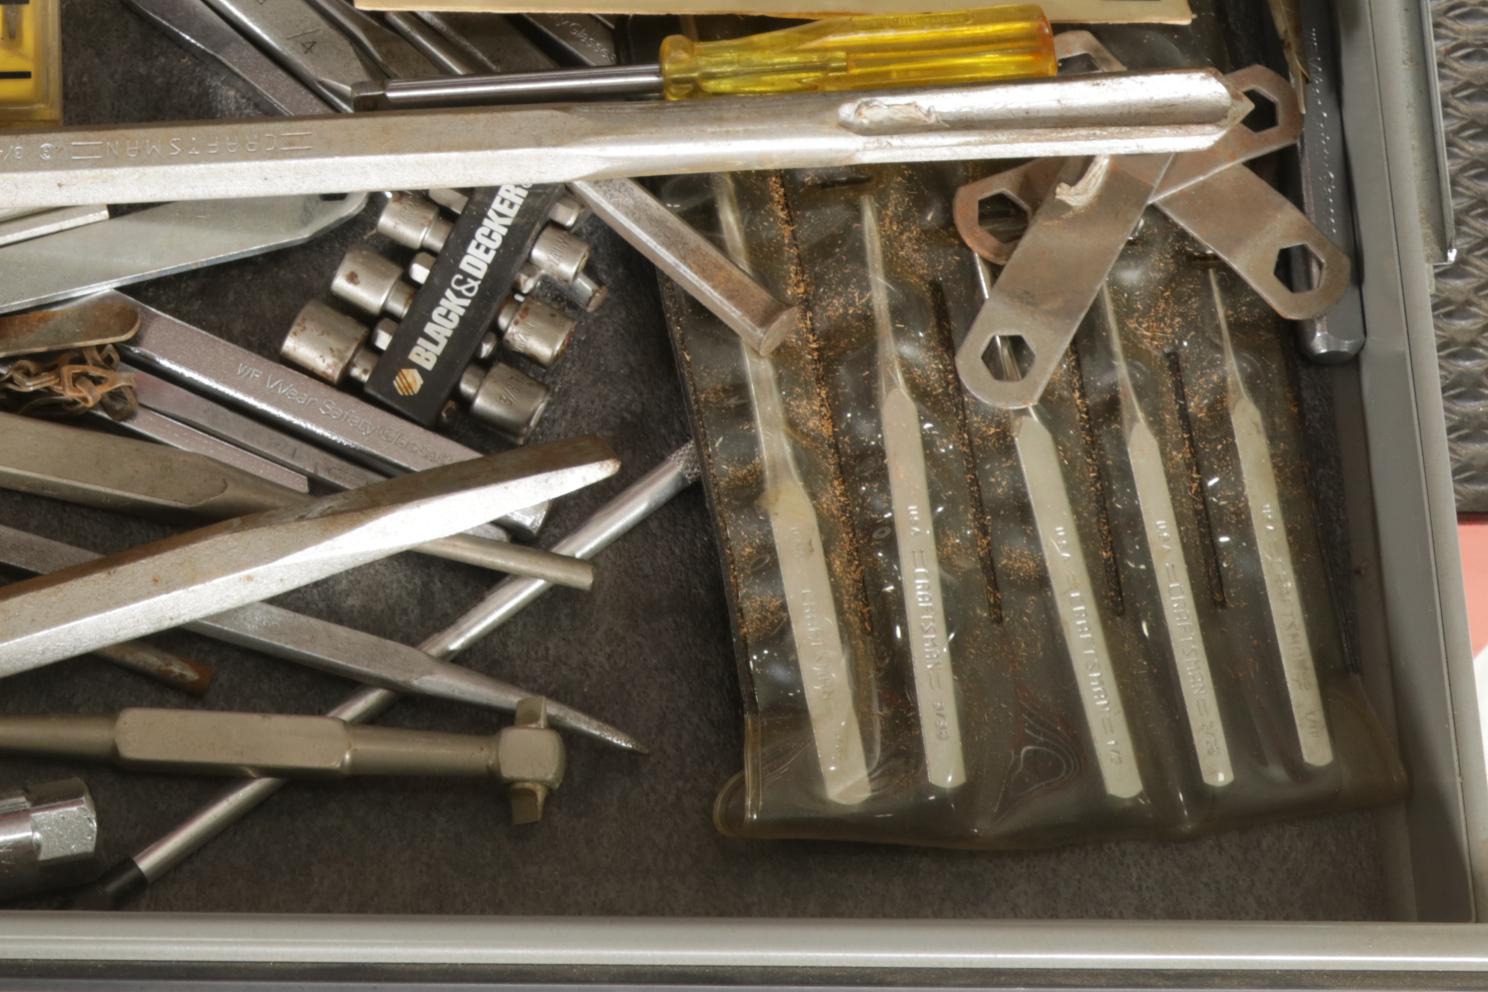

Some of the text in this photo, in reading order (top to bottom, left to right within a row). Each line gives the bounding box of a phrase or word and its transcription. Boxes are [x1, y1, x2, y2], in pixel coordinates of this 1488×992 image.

[105, 133, 278, 157] CRAFTSMAN
[407, 177, 530, 373] BLACK&DECKER
[911, 565, 942, 672] CRAFTSMAN
